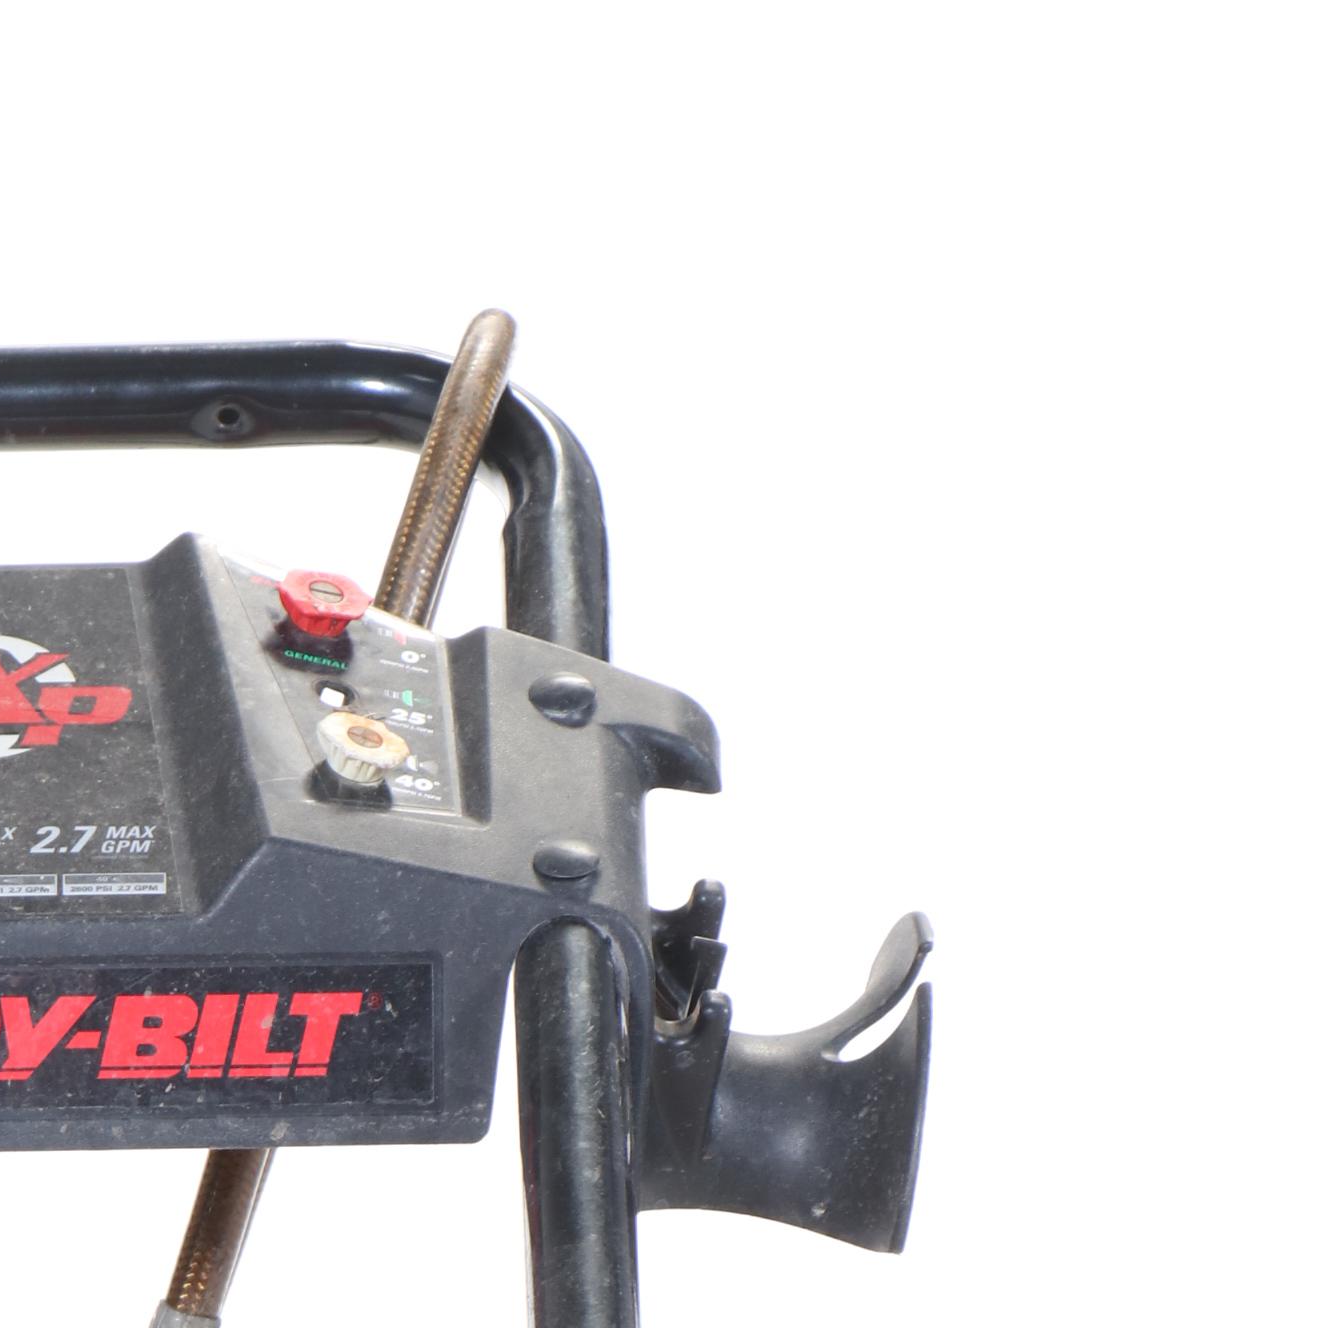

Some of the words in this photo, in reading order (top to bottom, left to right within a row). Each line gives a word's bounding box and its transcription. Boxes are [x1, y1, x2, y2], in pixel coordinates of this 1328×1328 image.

[283, 649, 350, 671] GENERAL
[29, 825, 98, 854] 2.7
[105, 825, 157, 840] MAX
[100, 839, 153, 854] GPM
[24, 886, 50, 894] GPM
[133, 884, 159, 892] GPM
